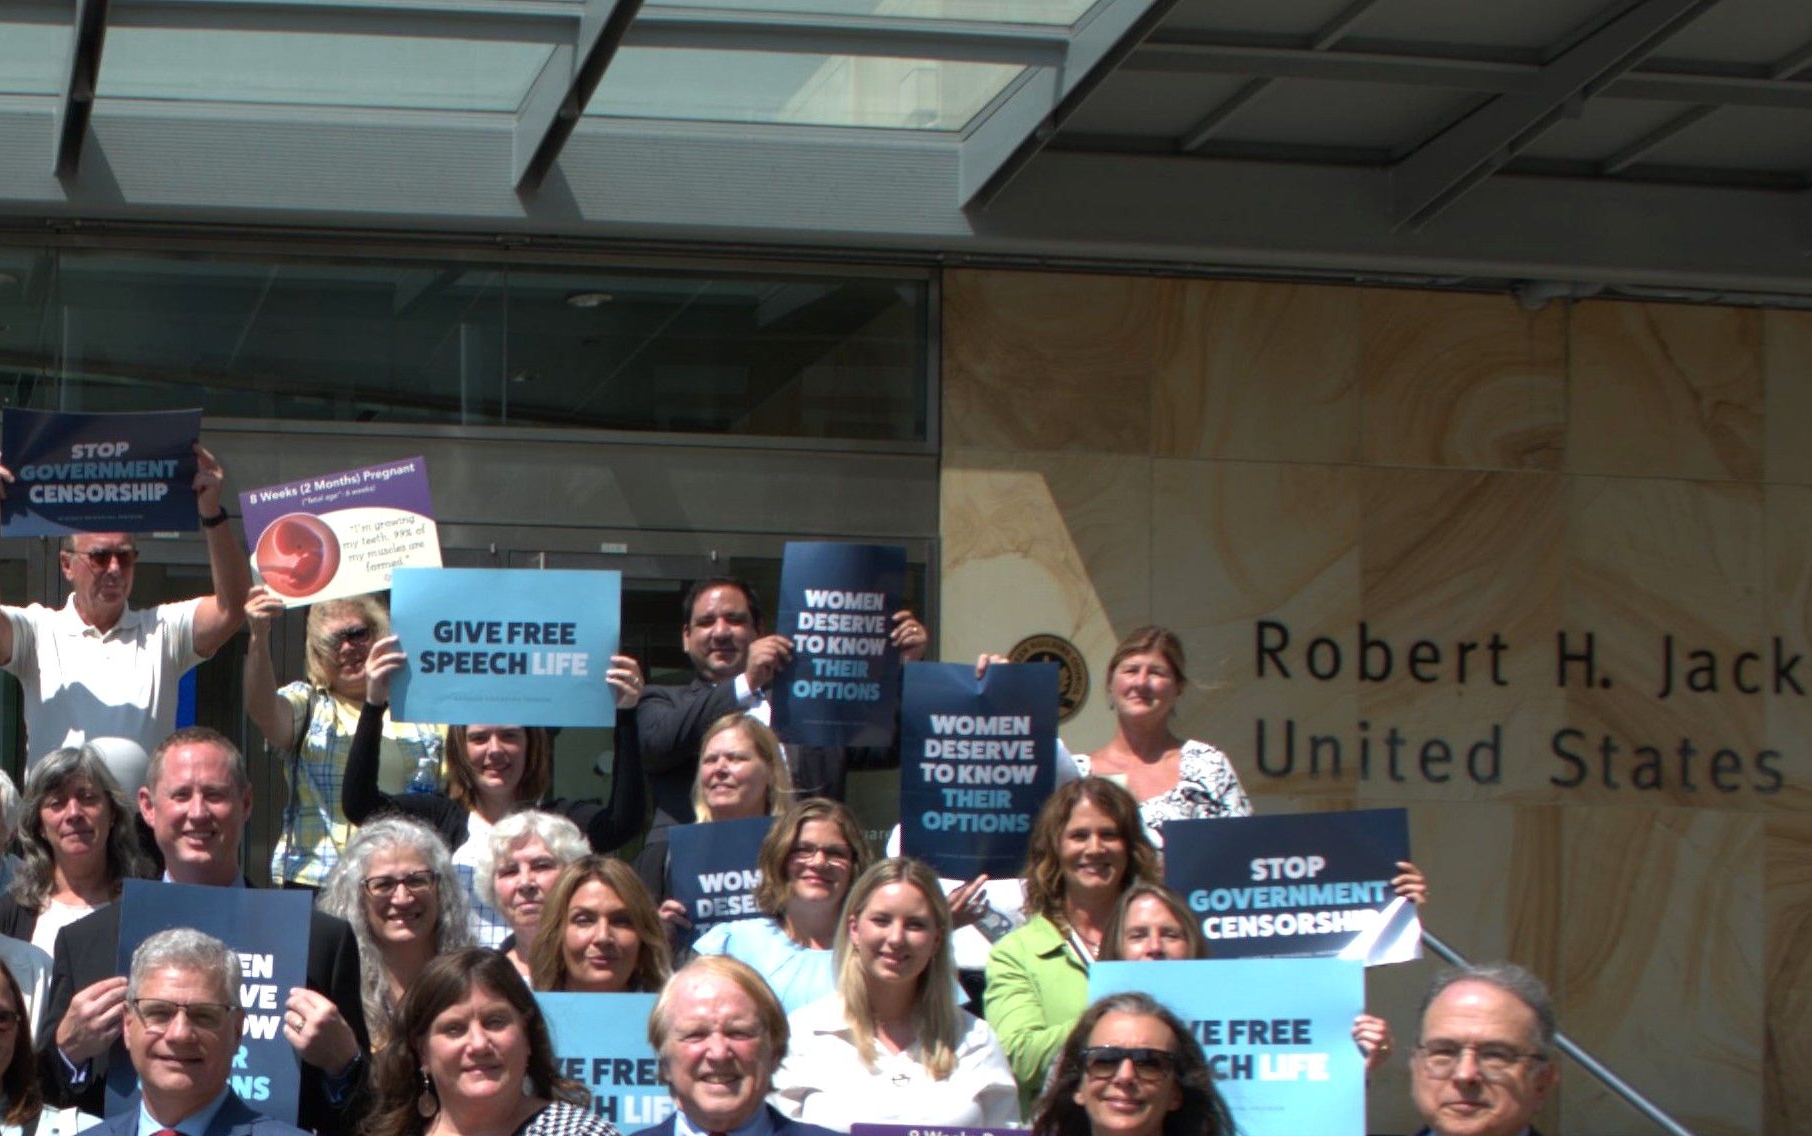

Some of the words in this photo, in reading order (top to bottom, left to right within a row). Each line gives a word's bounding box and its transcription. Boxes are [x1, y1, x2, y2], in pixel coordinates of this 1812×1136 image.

[71, 442, 129, 459] STOP
[20, 460, 179, 481] GOVERNMENT
[29, 483, 169, 503] CENSORSHIP
[250, 494, 257, 504] 8
[260, 487, 298, 502] Weeks
[300, 483, 311, 496] (2
[314, 474, 360, 490] Months)
[363, 464, 415, 481] Pregnant
[374, 516, 415, 531] growing
[343, 540, 358, 549] my
[415, 523, 425, 534] of
[348, 553, 364, 562] my
[367, 544, 406, 559] muscles
[409, 542, 425, 550] are
[804, 589, 885, 611] WOMEN
[434, 620, 502, 644] GIVE
[508, 623, 576, 645] FREE
[798, 612, 886, 633] DESERVE
[793, 634, 824, 654] TO
[827, 636, 886, 655] KNOW
[1256, 621, 1509, 686] Robert
[1556, 630, 1613, 690] H.
[420, 651, 527, 675] SPEECH
[532, 653, 587, 676] LIFE
[812, 659, 869, 678] THEIR
[792, 679, 880, 701] OPTIONS
[930, 714, 1031, 736] WOMEN
[924, 739, 1035, 760] DESERVE
[1256, 719, 1502, 785] United
[1550, 727, 1785, 794] States
[919, 763, 954, 783] TO
[957, 764, 1037, 785] KNOW
[942, 788, 1012, 809] THEIR
[922, 811, 1030, 833] OPTIONS
[1250, 855, 1326, 881] STOP
[698, 869, 763, 893] WOM
[696, 894, 762, 918] DESE
[1188, 880, 1388, 912] GOVERNMENT
[1228, 1020, 1311, 1046] FREE
[593, 1058, 662, 1086] FRE
[1259, 1053, 1330, 1082] LIFE
[624, 1095, 675, 1124] LIF
